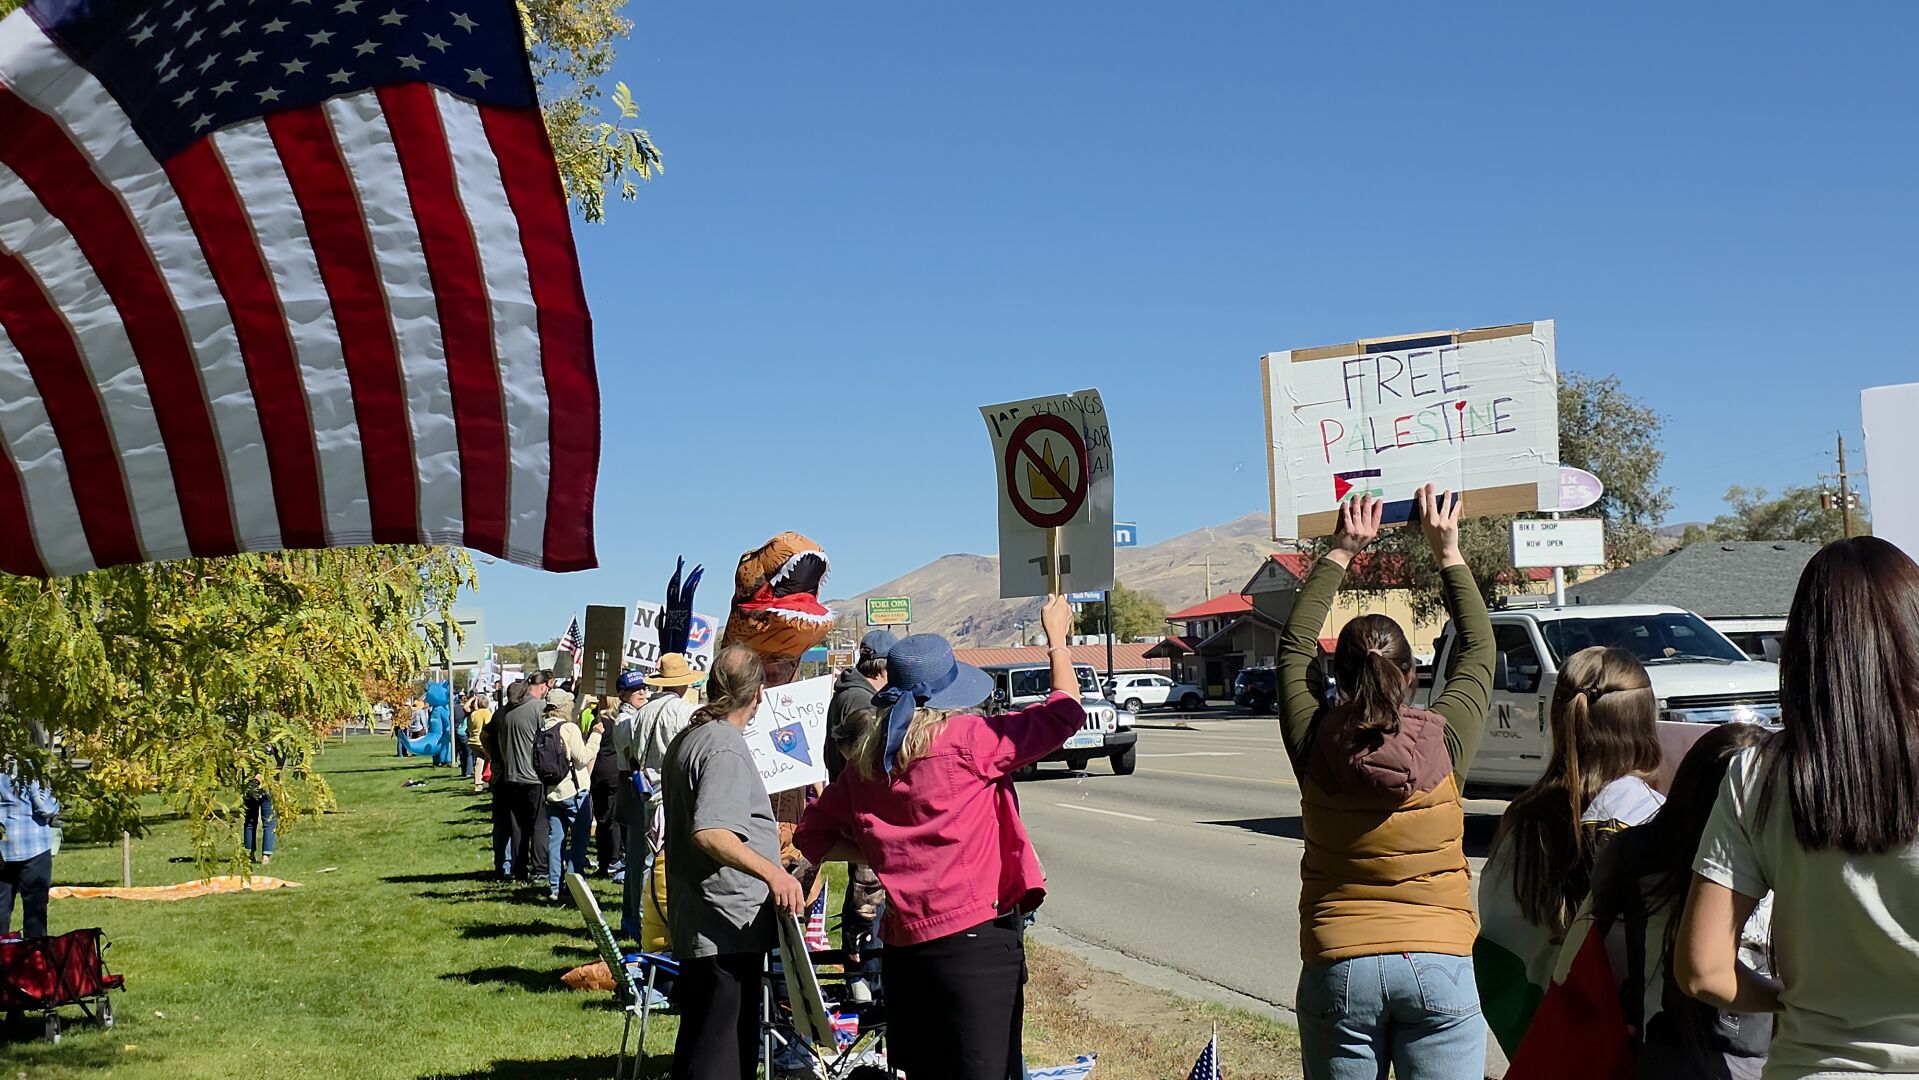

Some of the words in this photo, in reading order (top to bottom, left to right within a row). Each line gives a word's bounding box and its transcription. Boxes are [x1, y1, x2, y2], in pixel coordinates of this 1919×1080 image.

[1342, 345, 1474, 410] FREE
[1518, 523, 1536, 531] BIKE
[1540, 523, 1558, 531] SHOP
[1526, 540, 1541, 548] NOW
[764, 690, 825, 731] Kings
